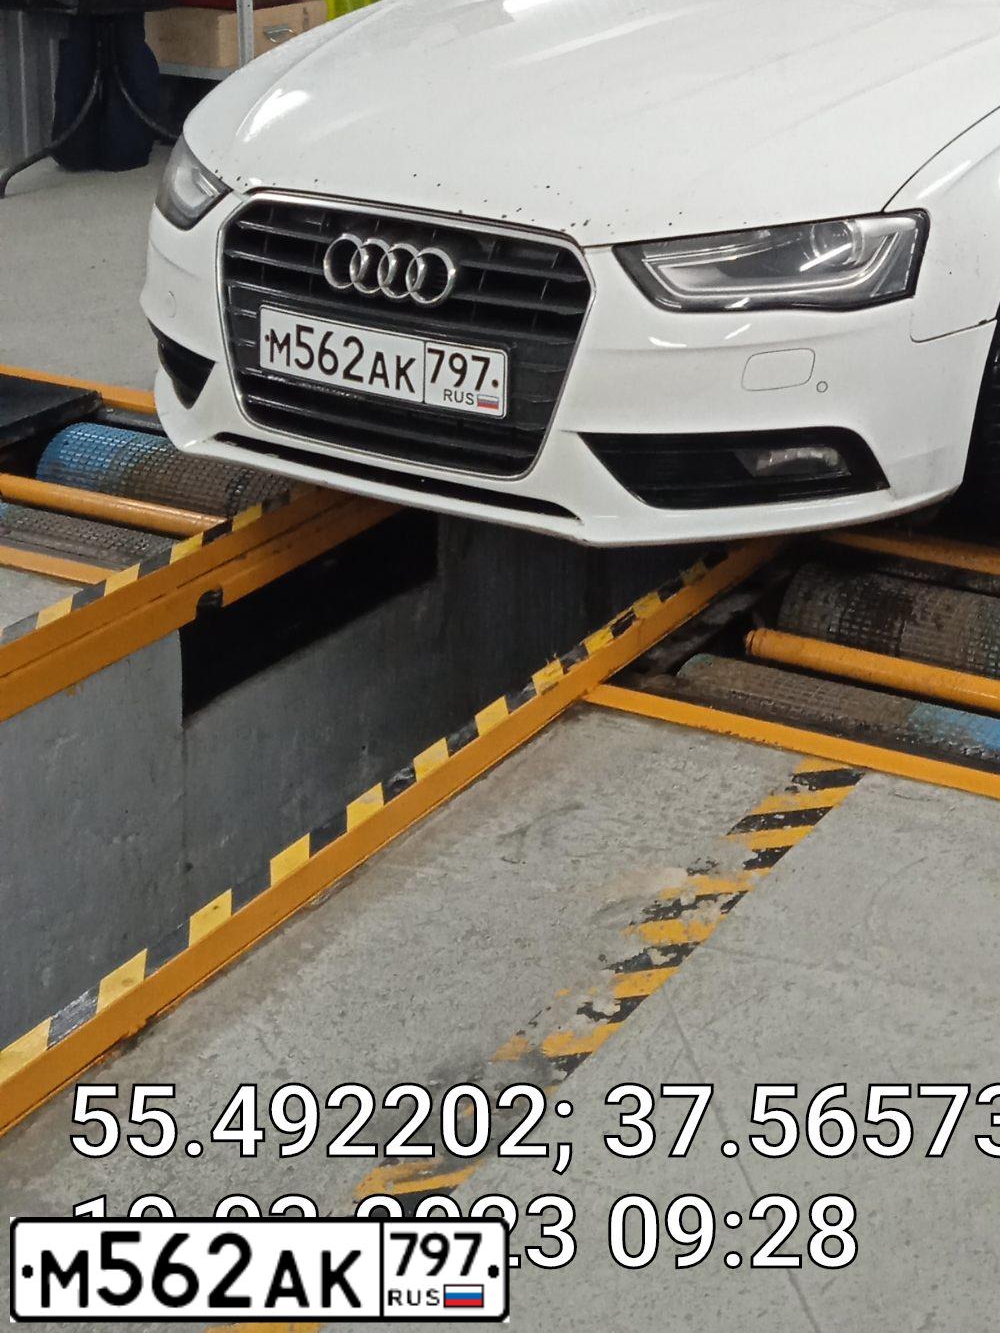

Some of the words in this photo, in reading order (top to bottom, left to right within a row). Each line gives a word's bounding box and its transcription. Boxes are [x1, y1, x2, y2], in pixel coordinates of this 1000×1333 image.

[269, 323, 416, 394] М562АК
[427, 347, 491, 392] 797
[443, 388, 475, 406] RUS
